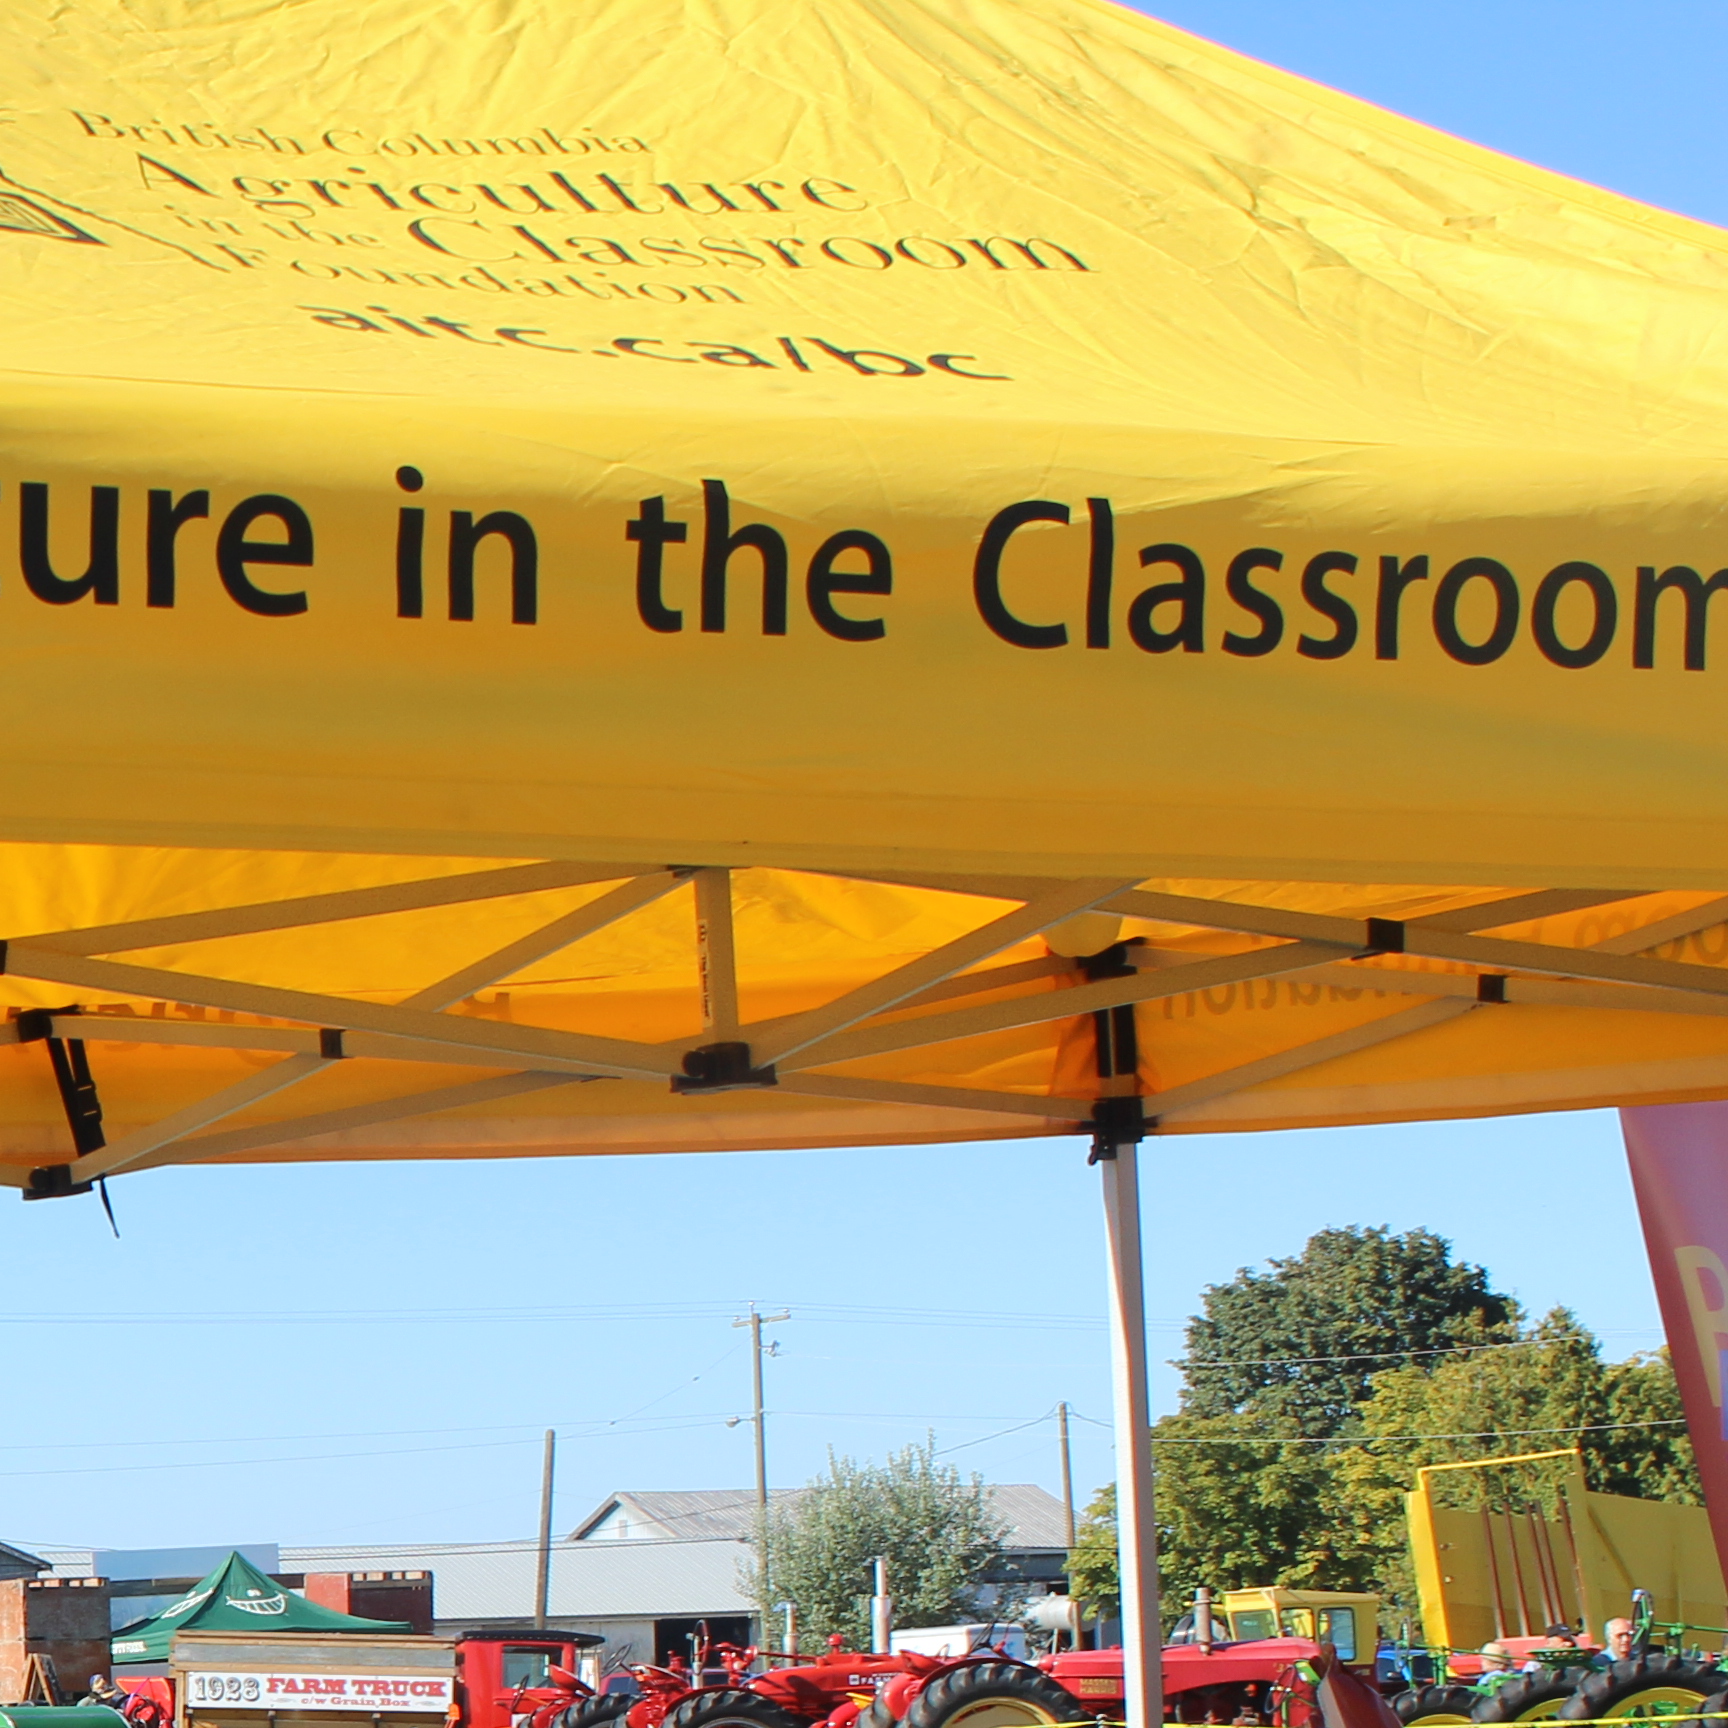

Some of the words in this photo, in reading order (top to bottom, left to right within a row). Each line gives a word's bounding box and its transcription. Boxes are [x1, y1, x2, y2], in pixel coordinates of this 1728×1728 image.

[69, 109, 307, 156] British
[322, 125, 652, 158] Columbia
[136, 152, 868, 217] Agriculture
[163, 204, 243, 236] in
[262, 219, 385, 250] the
[408, 216, 1101, 273] Classroom
[212, 243, 752, 304] Foundation
[294, 304, 1014, 381] aitc.ca/bc
[395, 465, 538, 626] in
[626, 478, 893, 642] the
[973, 496, 1728, 672] Classroom
[195, 1676, 260, 1701] 1923
[267, 1678, 347, 1696] FARM
[352, 1680, 447, 1698] TRUCK
[330, 1697, 375, 1706] Grain
[376, 1698, 411, 1707] Box
